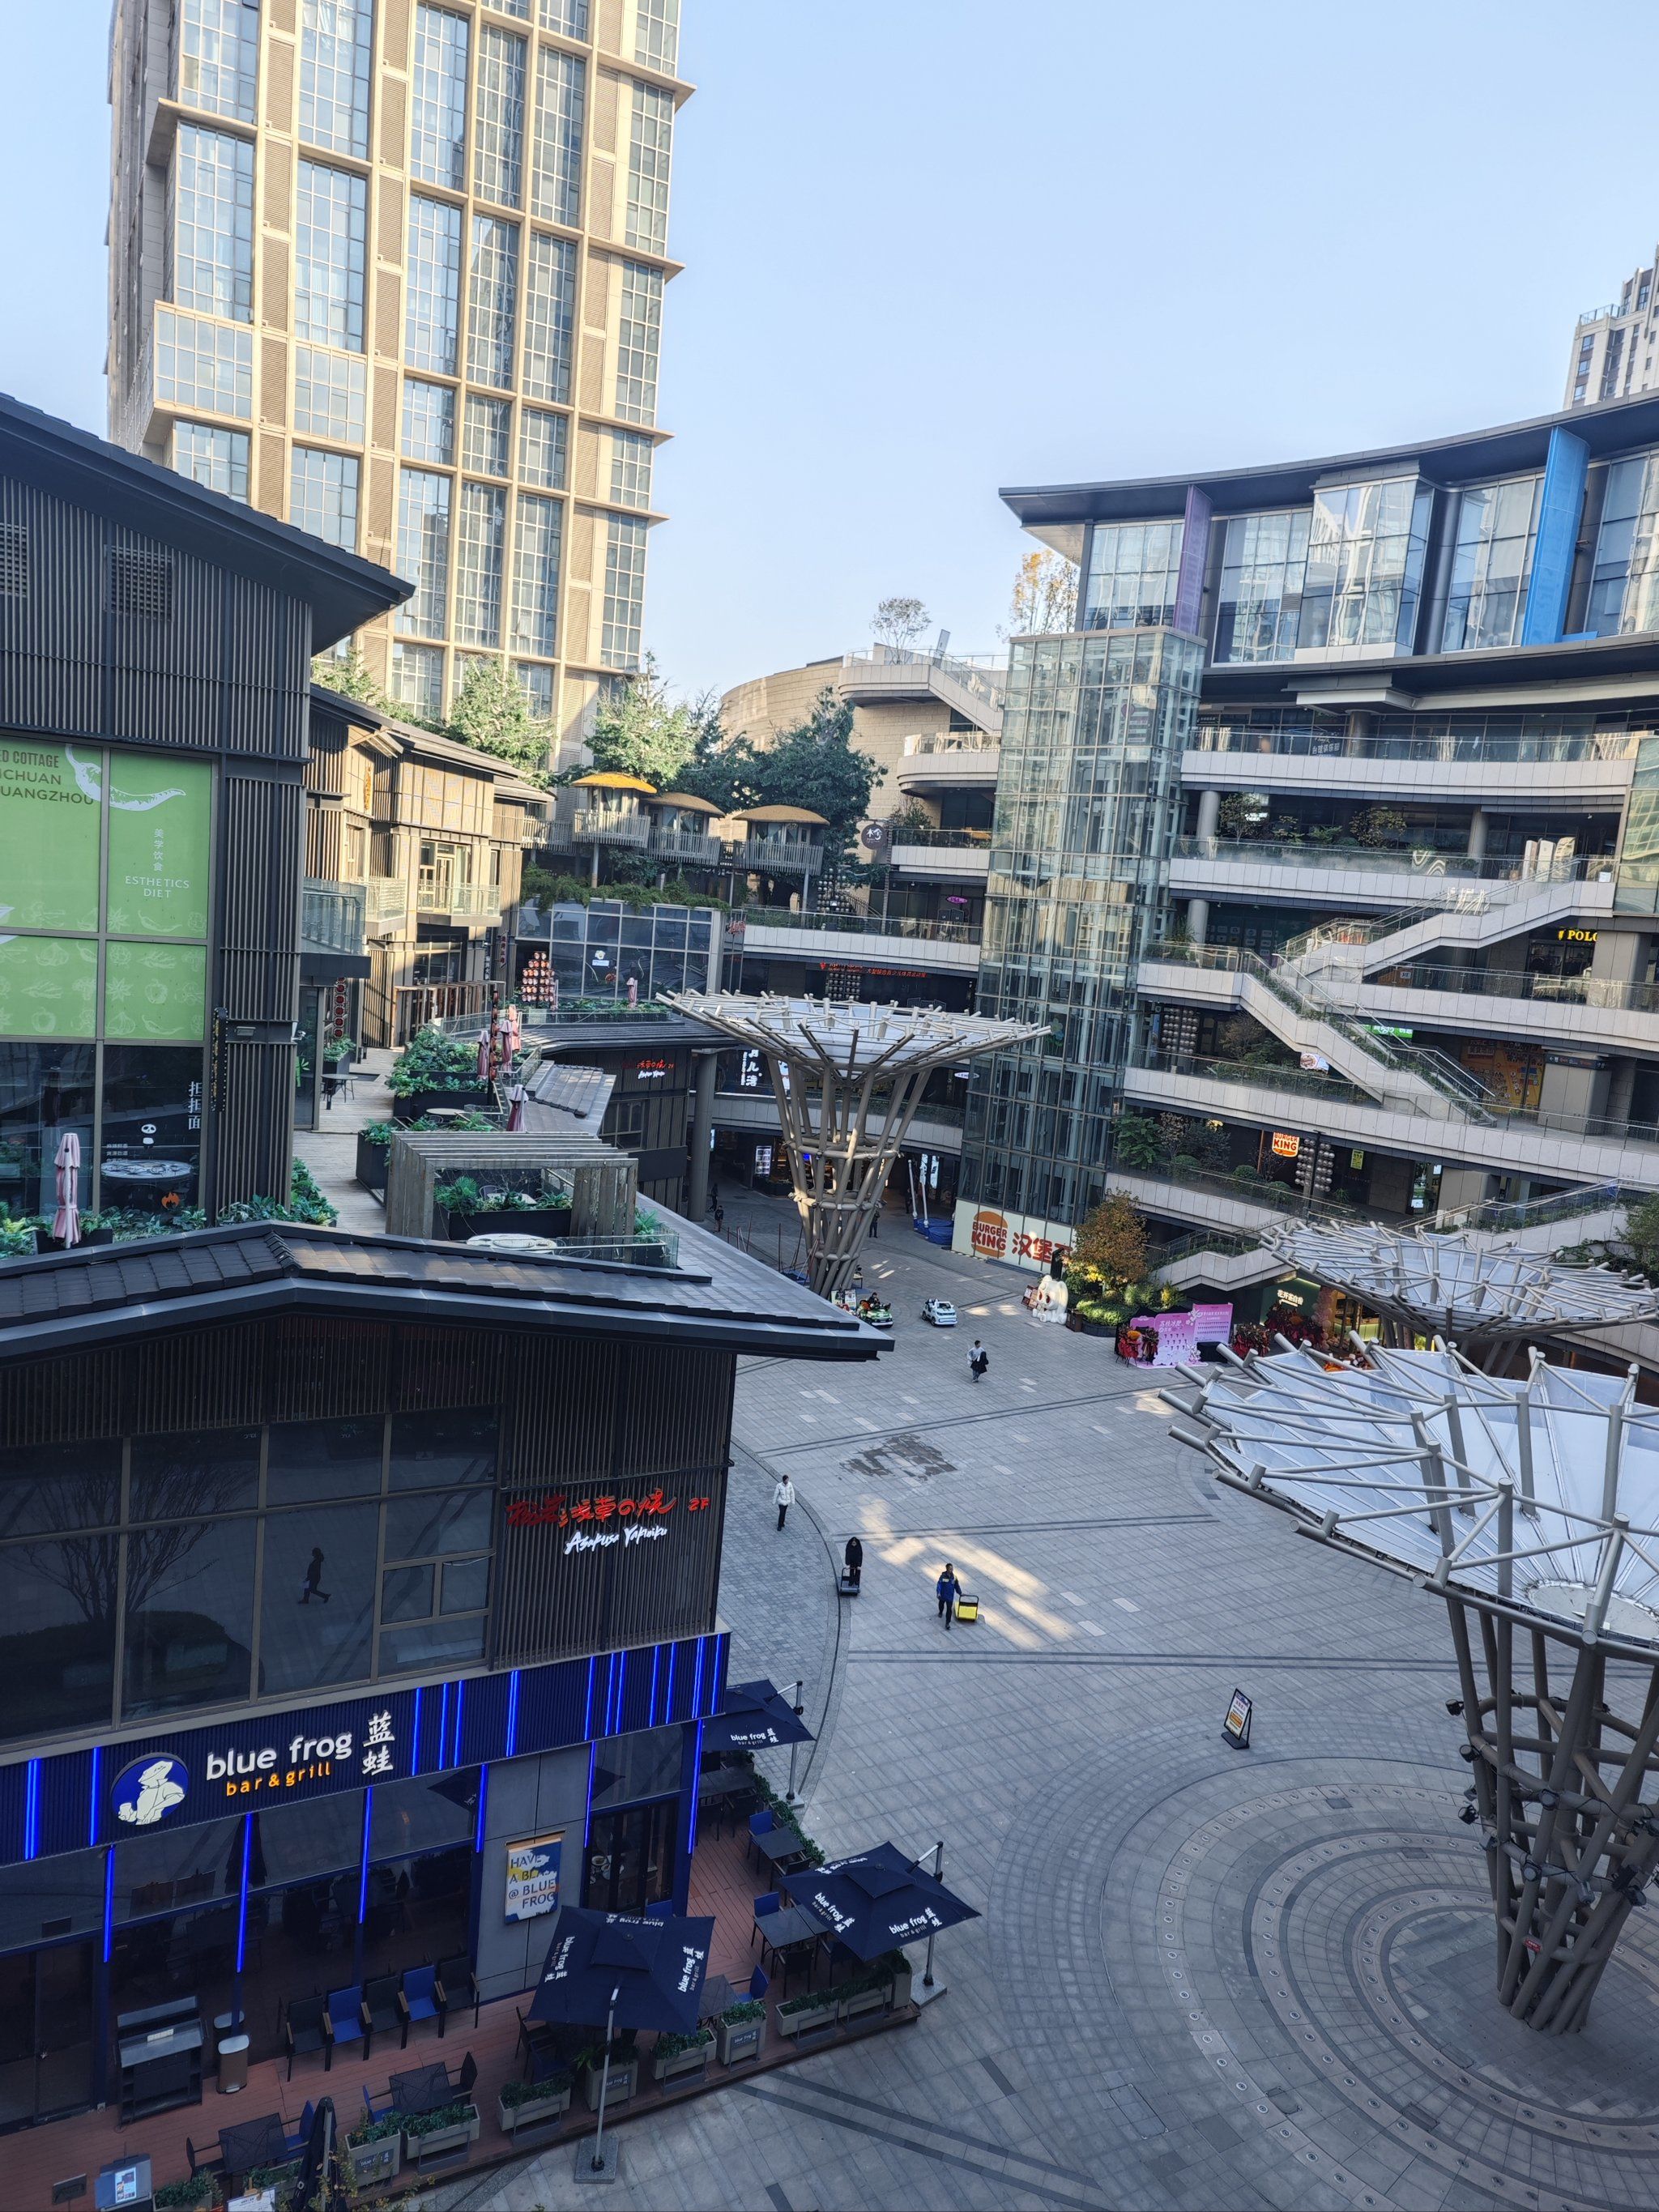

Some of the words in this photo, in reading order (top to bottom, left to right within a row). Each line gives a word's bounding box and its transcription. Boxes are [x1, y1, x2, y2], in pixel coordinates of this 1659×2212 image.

[13, 751, 59, 769] COTTAGE
[125, 876, 190, 889] ESTHETICS
[143, 888, 172, 898] DIET
[187, 1080, 203, 1130] 担担面
[1273, 1139, 1297, 1151] KING
[972, 1221, 1007, 1238] BURGER
[971, 1230, 1006, 1251] KING
[688, 1497, 710, 1512] 2F
[565, 1530, 620, 1555] Asakusa
[624, 1524, 668, 1548] Yakiniku
[361, 1709, 395, 1776] 蓝蛙
[749, 1733, 766, 1741] frog
[206, 1747, 277, 1780] blue
[288, 1732, 352, 1764] frog
[510, 1855, 542, 1869] HAVE
[509, 1873, 518, 1884] A
[522, 1869, 553, 1882] BLA
[508, 1889, 518, 1899] @
[522, 1879, 556, 1896] BLUE
[814, 1892, 830, 1908] blue
[827, 1904, 844, 1922] frog
[888, 1922, 910, 1935] blue
[909, 1914, 928, 1929] frog
[561, 1936, 576, 1954] blue
[555, 1953, 569, 1971] frog
[682, 1957, 696, 1975] frog
[677, 1974, 690, 1993] blue
